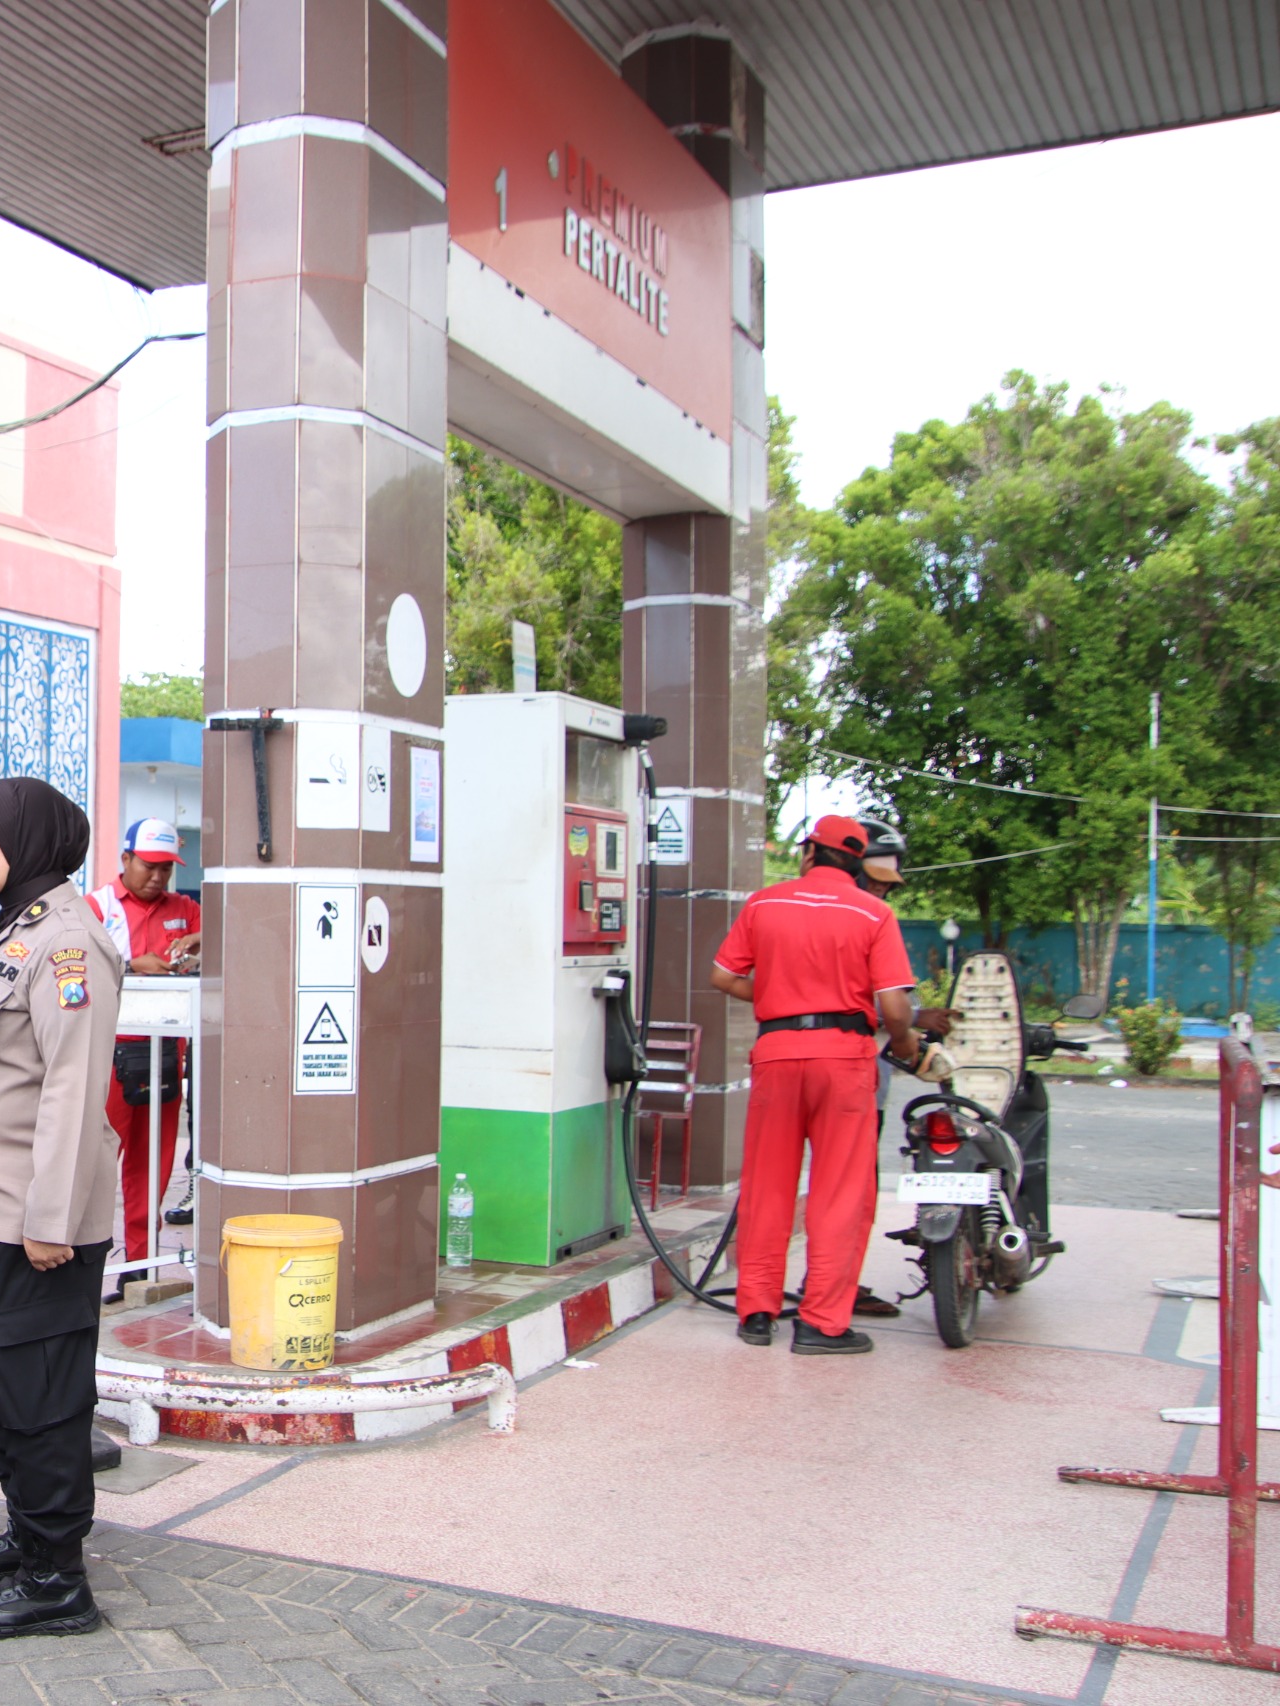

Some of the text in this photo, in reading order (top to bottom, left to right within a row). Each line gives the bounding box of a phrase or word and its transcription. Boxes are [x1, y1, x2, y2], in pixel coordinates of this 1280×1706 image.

[495, 165, 508, 232] 1
[566, 140, 668, 278] PREMIUM
[564, 206, 669, 338] PERTALITE
[305, 1294, 331, 1305] CERRO
